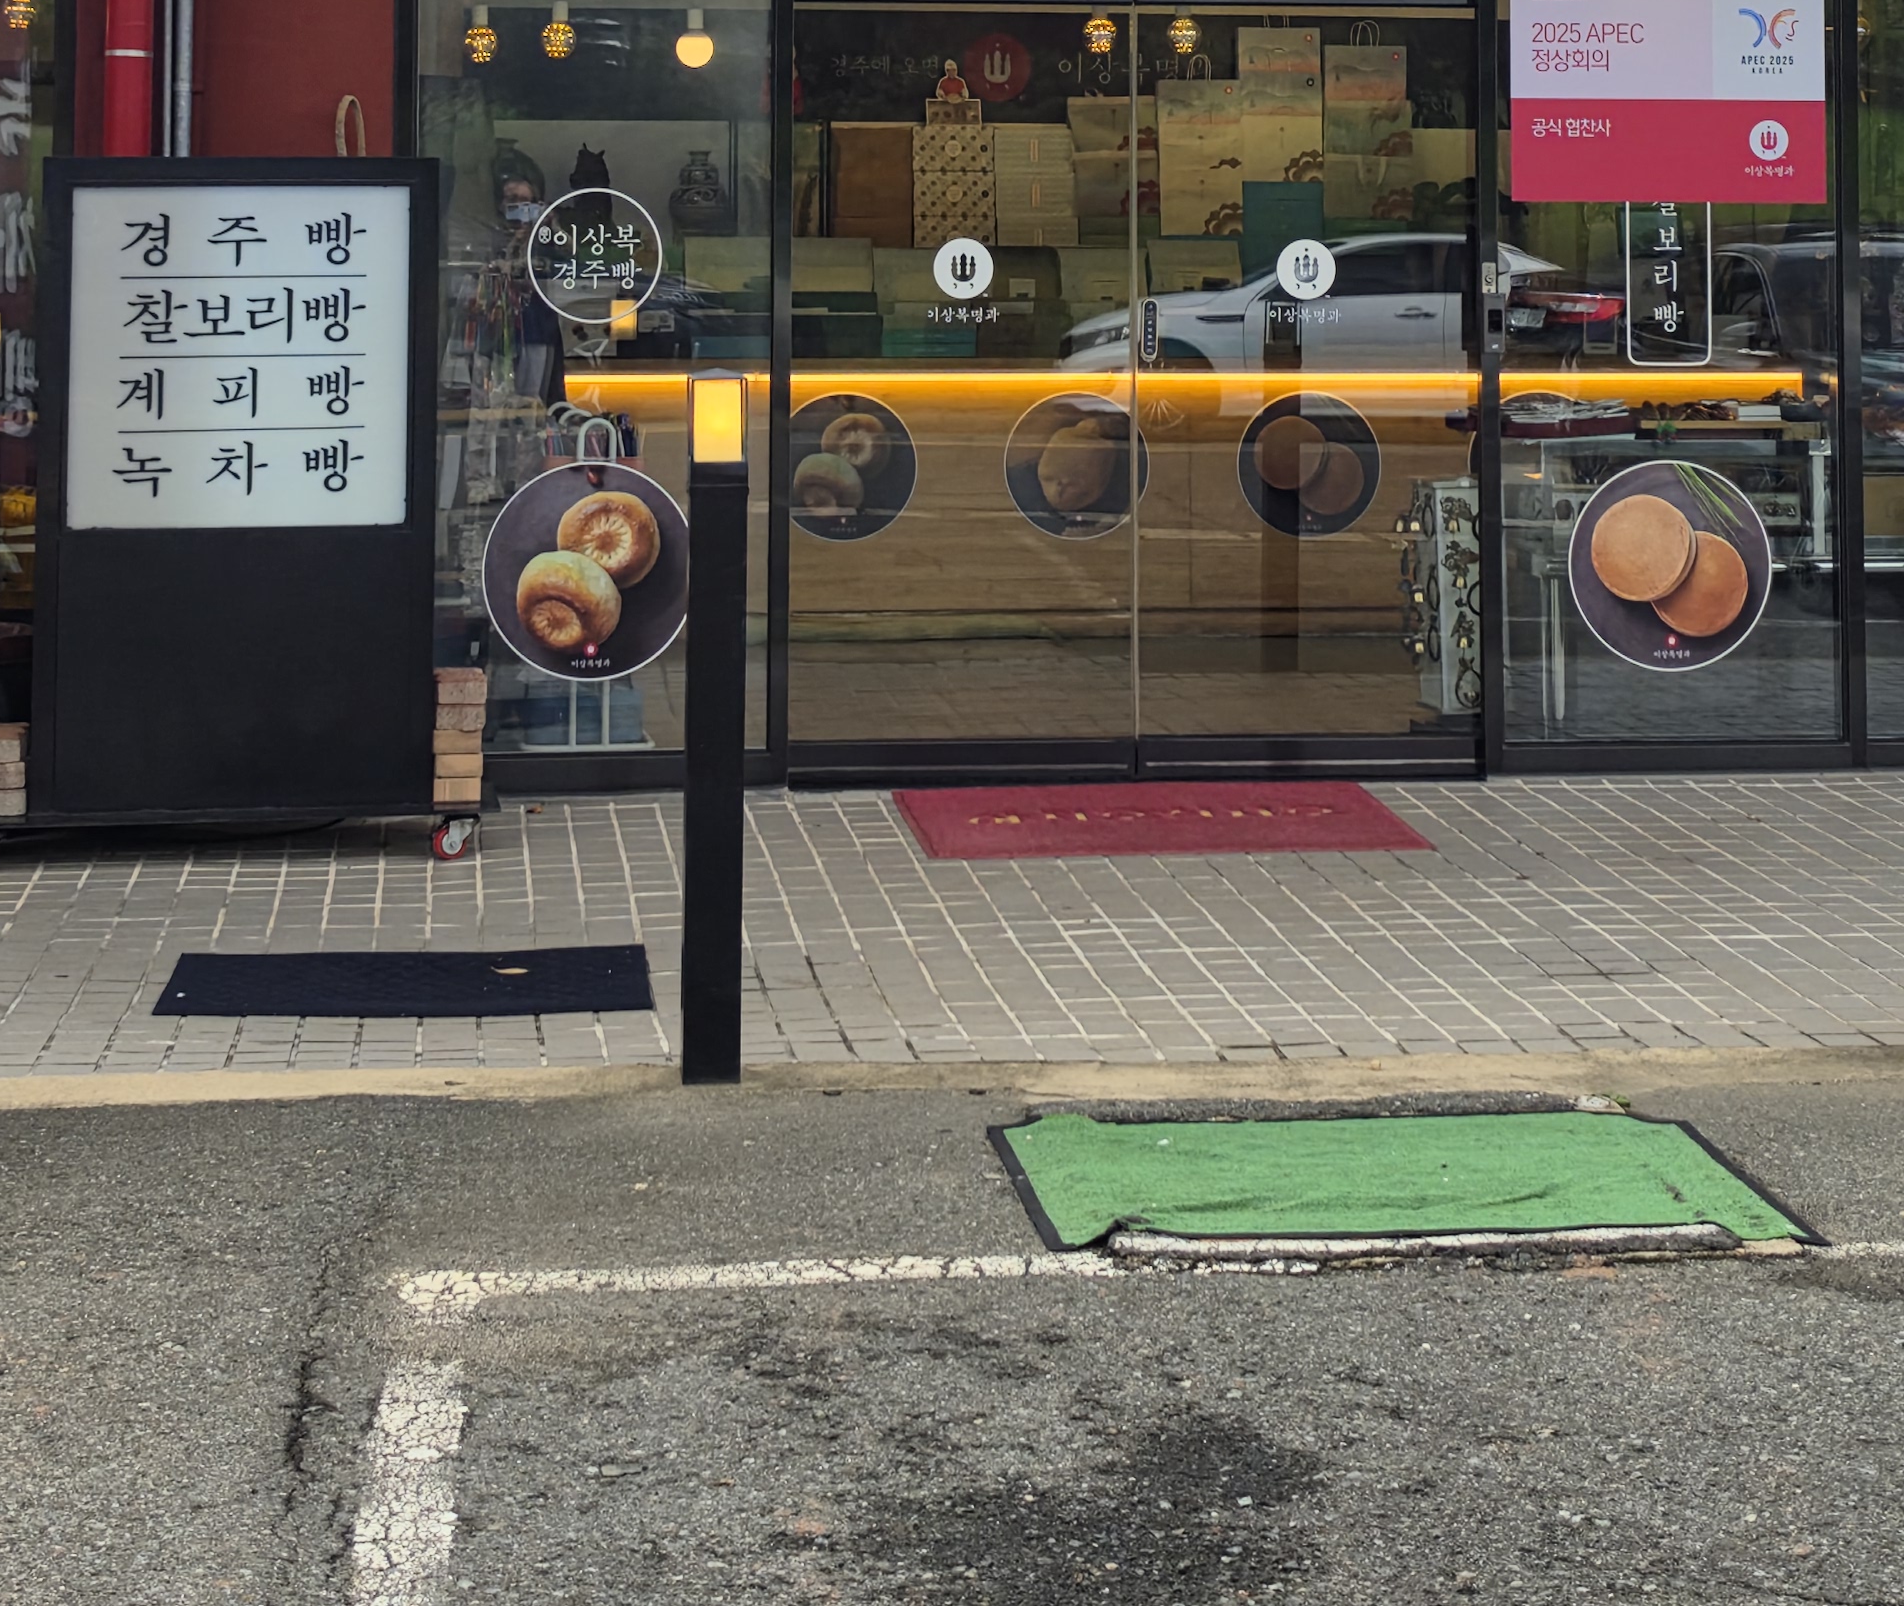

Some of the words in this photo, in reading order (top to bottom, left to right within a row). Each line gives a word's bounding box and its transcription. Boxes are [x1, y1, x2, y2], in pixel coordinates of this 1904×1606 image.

[1532, 23, 1581, 43] 2025
[1586, 22, 1645, 43] APEC
[1531, 48, 1610, 72] 정상회의
[1741, 55, 1765, 65] APEC
[1531, 118, 1562, 137] 공식
[1565, 118, 1612, 138] 협찬사
[120, 212, 367, 267] 경주빵
[553, 224, 641, 255] 이상복
[552, 259, 643, 289] 경주빵
[123, 287, 367, 344] 찰보리빵
[116, 365, 366, 420] 계피빵
[112, 439, 365, 497] 녹차빵
